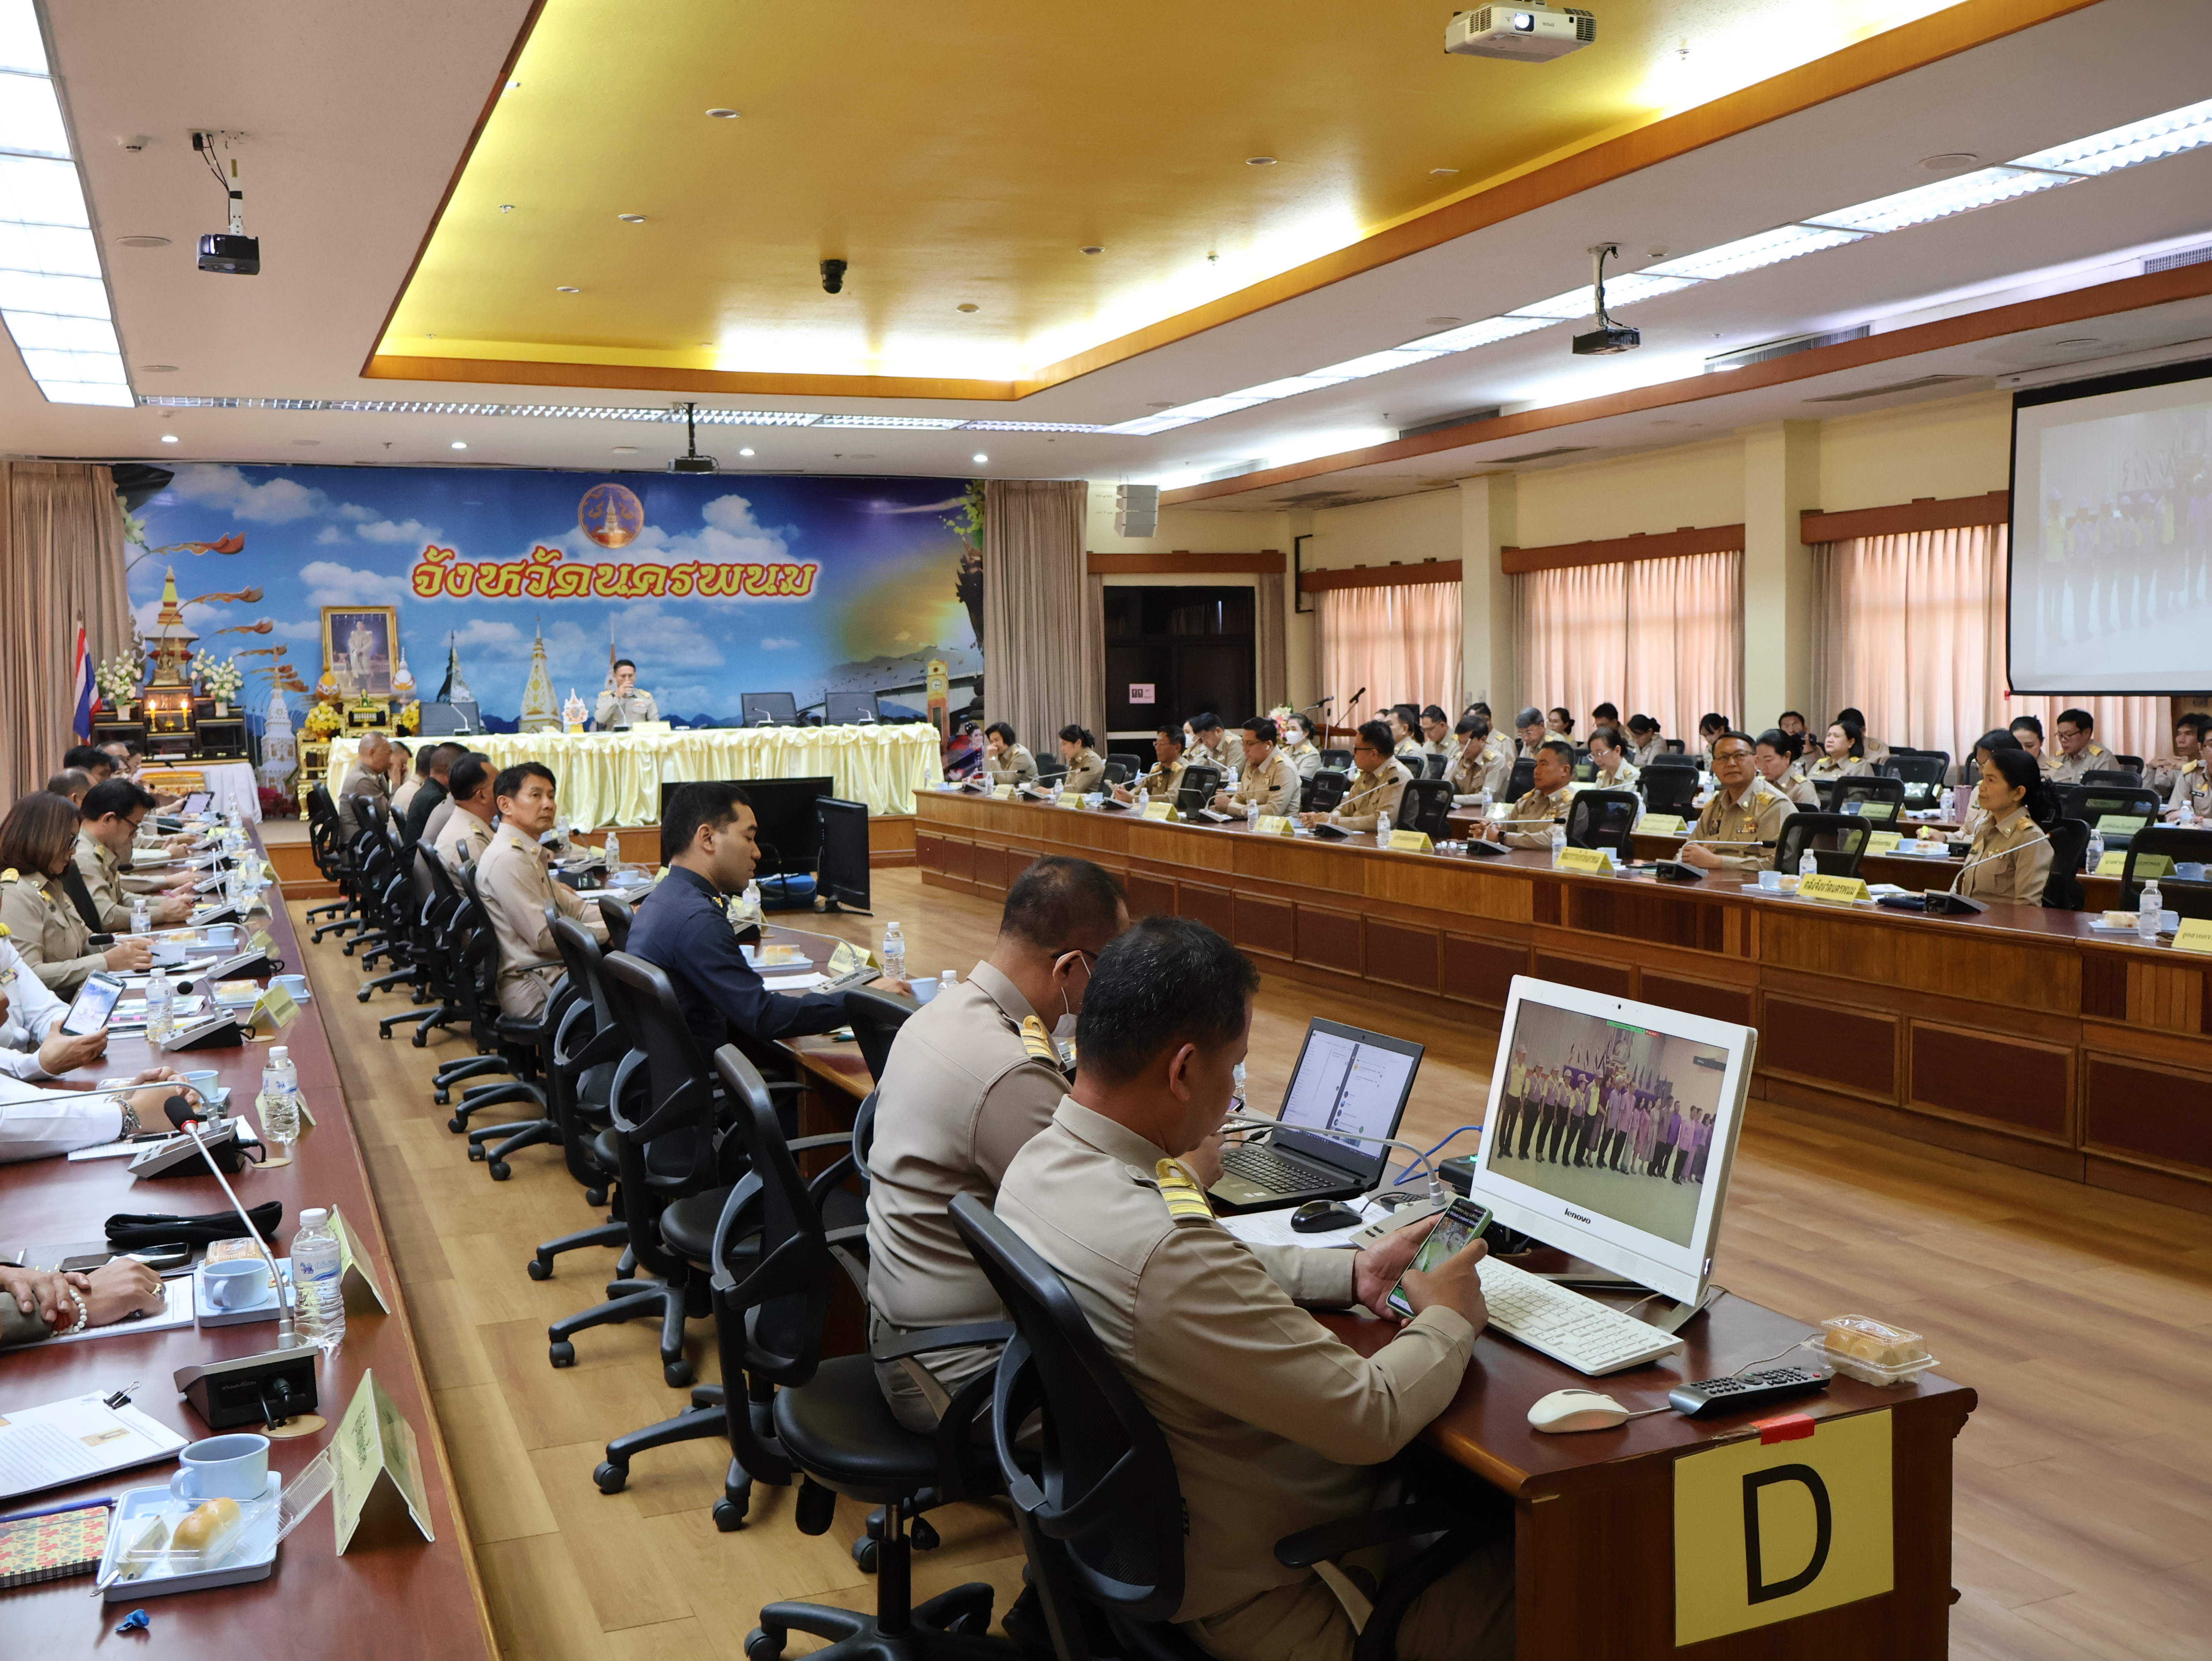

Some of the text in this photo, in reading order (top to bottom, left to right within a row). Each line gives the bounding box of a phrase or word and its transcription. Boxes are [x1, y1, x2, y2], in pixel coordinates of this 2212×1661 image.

[413, 545, 817, 598] จังหวัดนครพนม
[1564, 1208, 1591, 1224] lenovo
[1742, 1463, 1832, 1606] D
